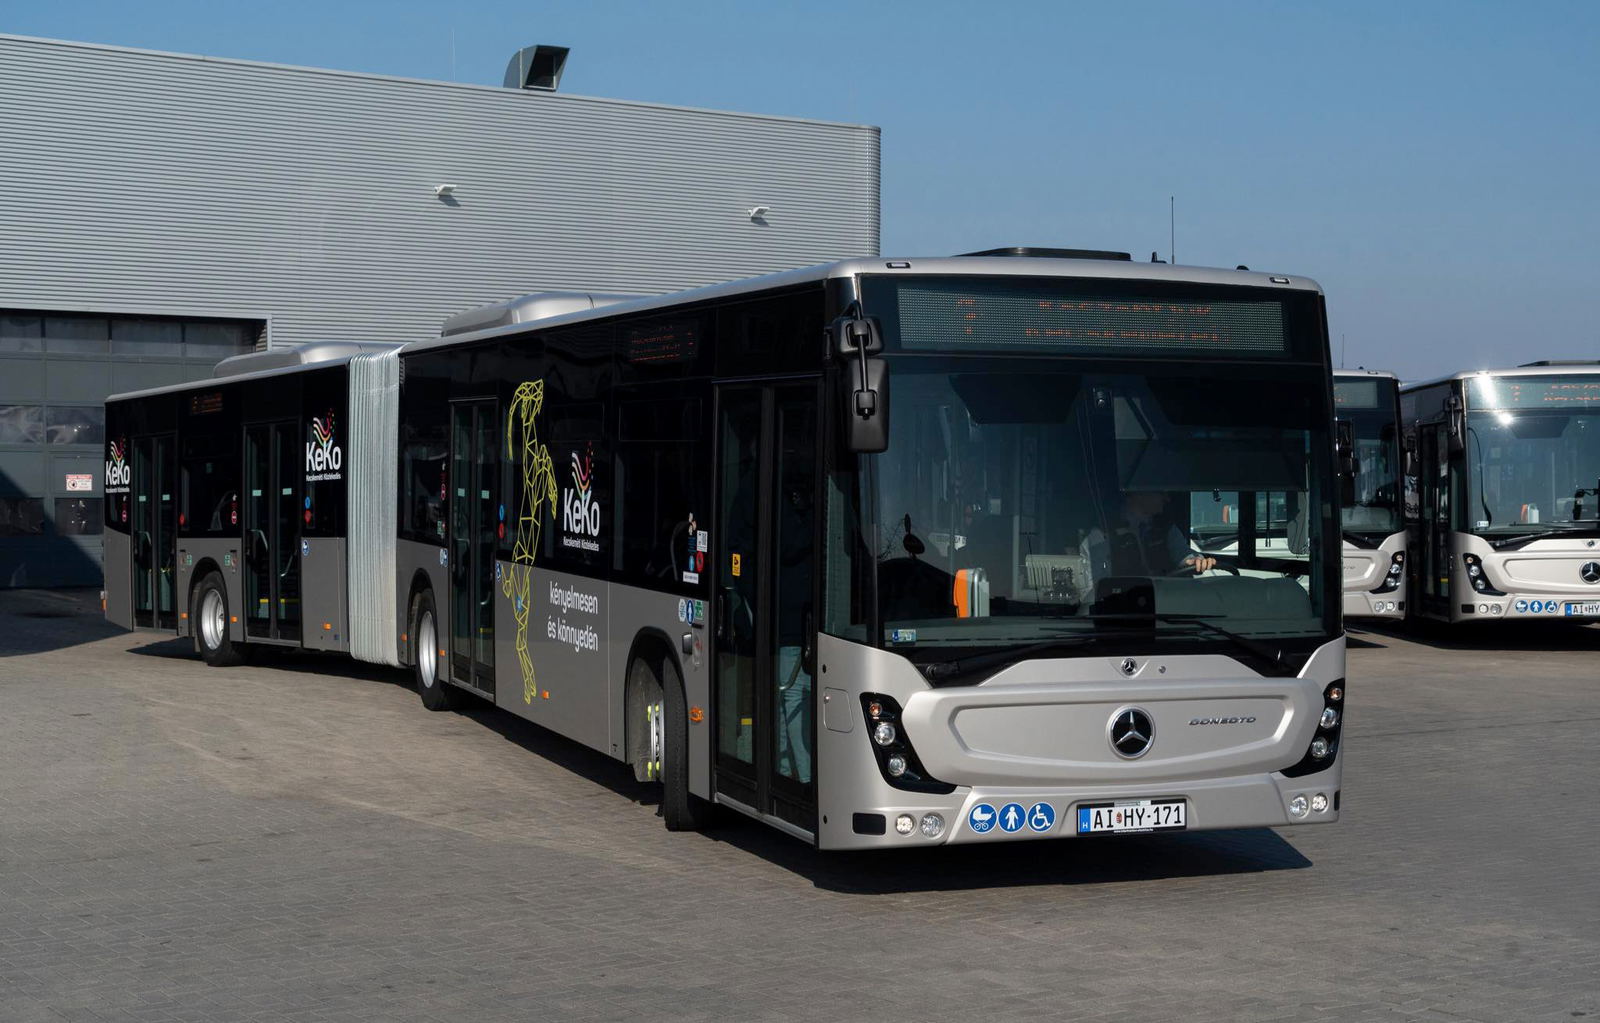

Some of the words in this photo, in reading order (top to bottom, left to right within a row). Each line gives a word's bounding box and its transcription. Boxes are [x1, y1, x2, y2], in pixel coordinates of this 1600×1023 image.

[306, 440, 342, 472] KeKo
[105, 460, 131, 485] KeKo
[563, 488, 600, 536] KeKo
[549, 580, 598, 614] kényelmesen
[1573, 605, 1584, 614] AI
[547, 615, 557, 639] és
[557, 617, 598, 653] könnyedén
[1093, 809, 1114, 829] AI
[1123, 805, 1182, 827] HY-171
